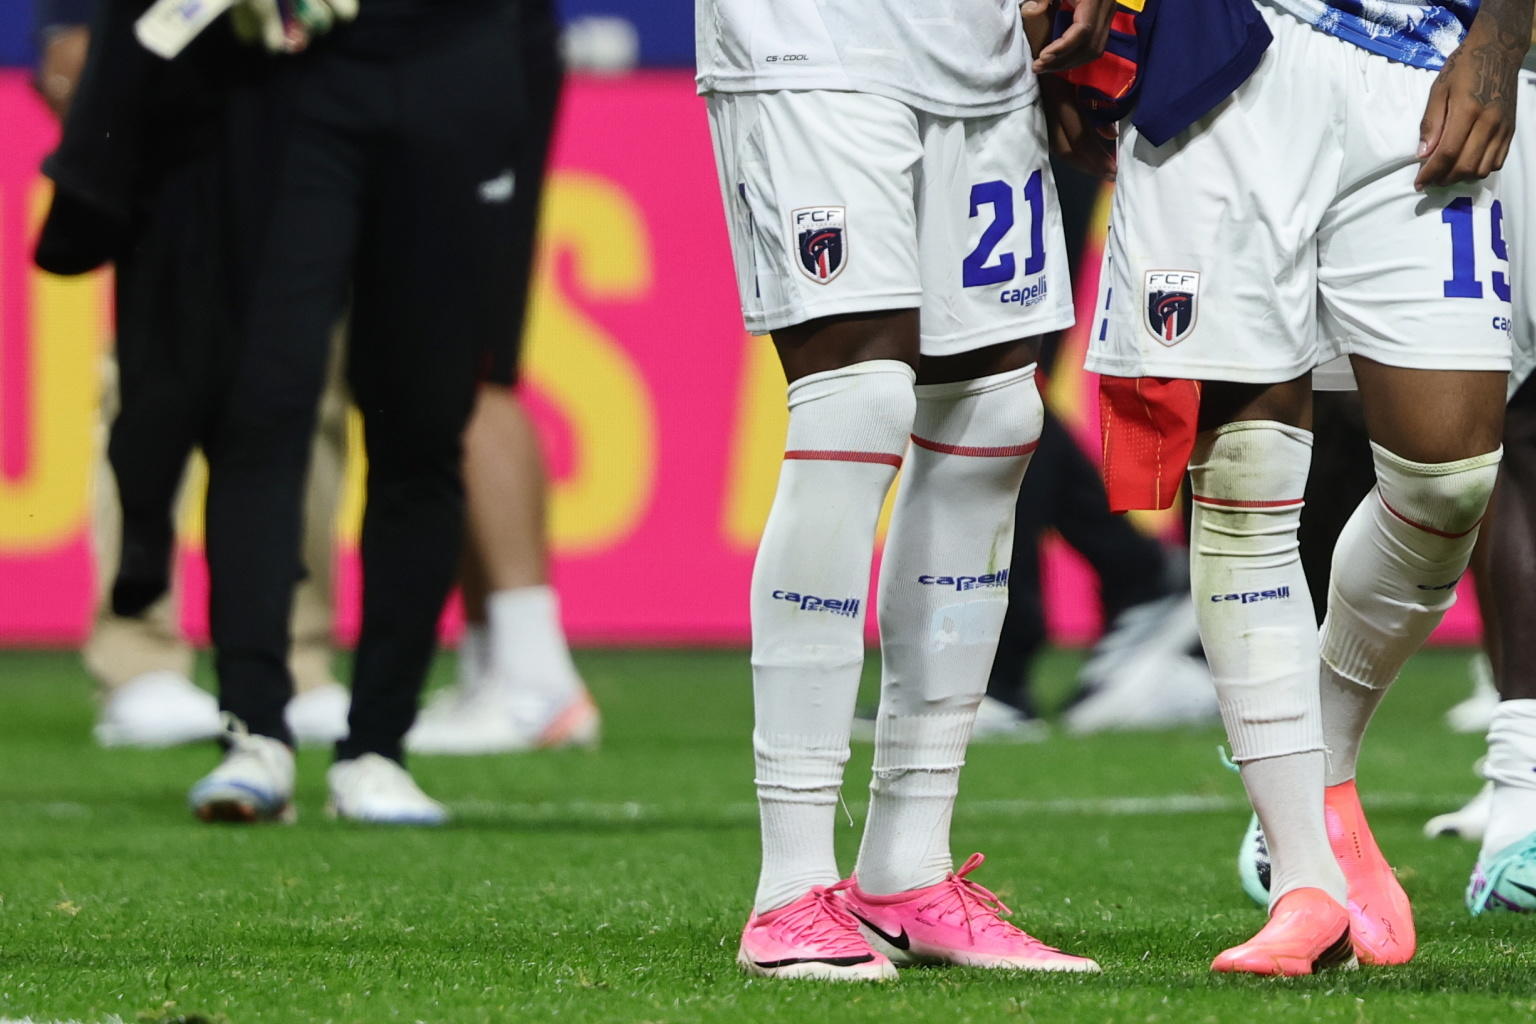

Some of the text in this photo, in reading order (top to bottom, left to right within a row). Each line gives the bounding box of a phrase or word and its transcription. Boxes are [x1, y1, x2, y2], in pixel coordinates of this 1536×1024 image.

[797, 210, 841, 225] FCF
[962, 169, 1047, 288] 21
[1000, 274, 1047, 306] capelli
[1149, 273, 1196, 286] FCF
[918, 568, 1009, 591] capelli
[772, 589, 860, 612] capelli
[1211, 586, 1290, 604] capelli
